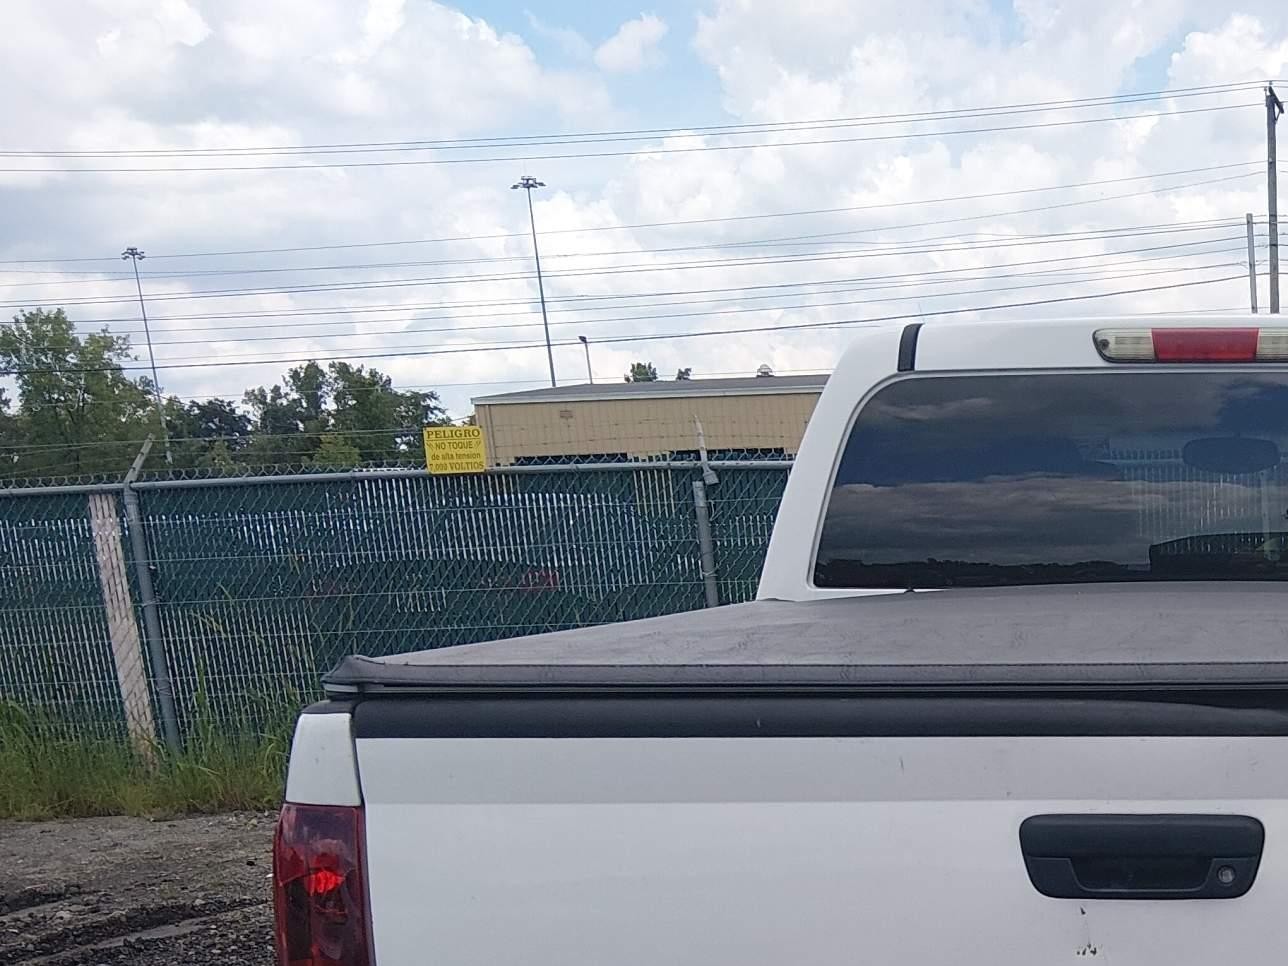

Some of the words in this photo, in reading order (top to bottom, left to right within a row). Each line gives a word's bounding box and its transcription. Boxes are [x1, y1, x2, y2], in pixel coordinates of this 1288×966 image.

[427, 428, 480, 440] PELIGRO
[436, 441, 446, 450] NO
[448, 441, 473, 449] TOQUE
[449, 461, 484, 471] VOLTIOS
